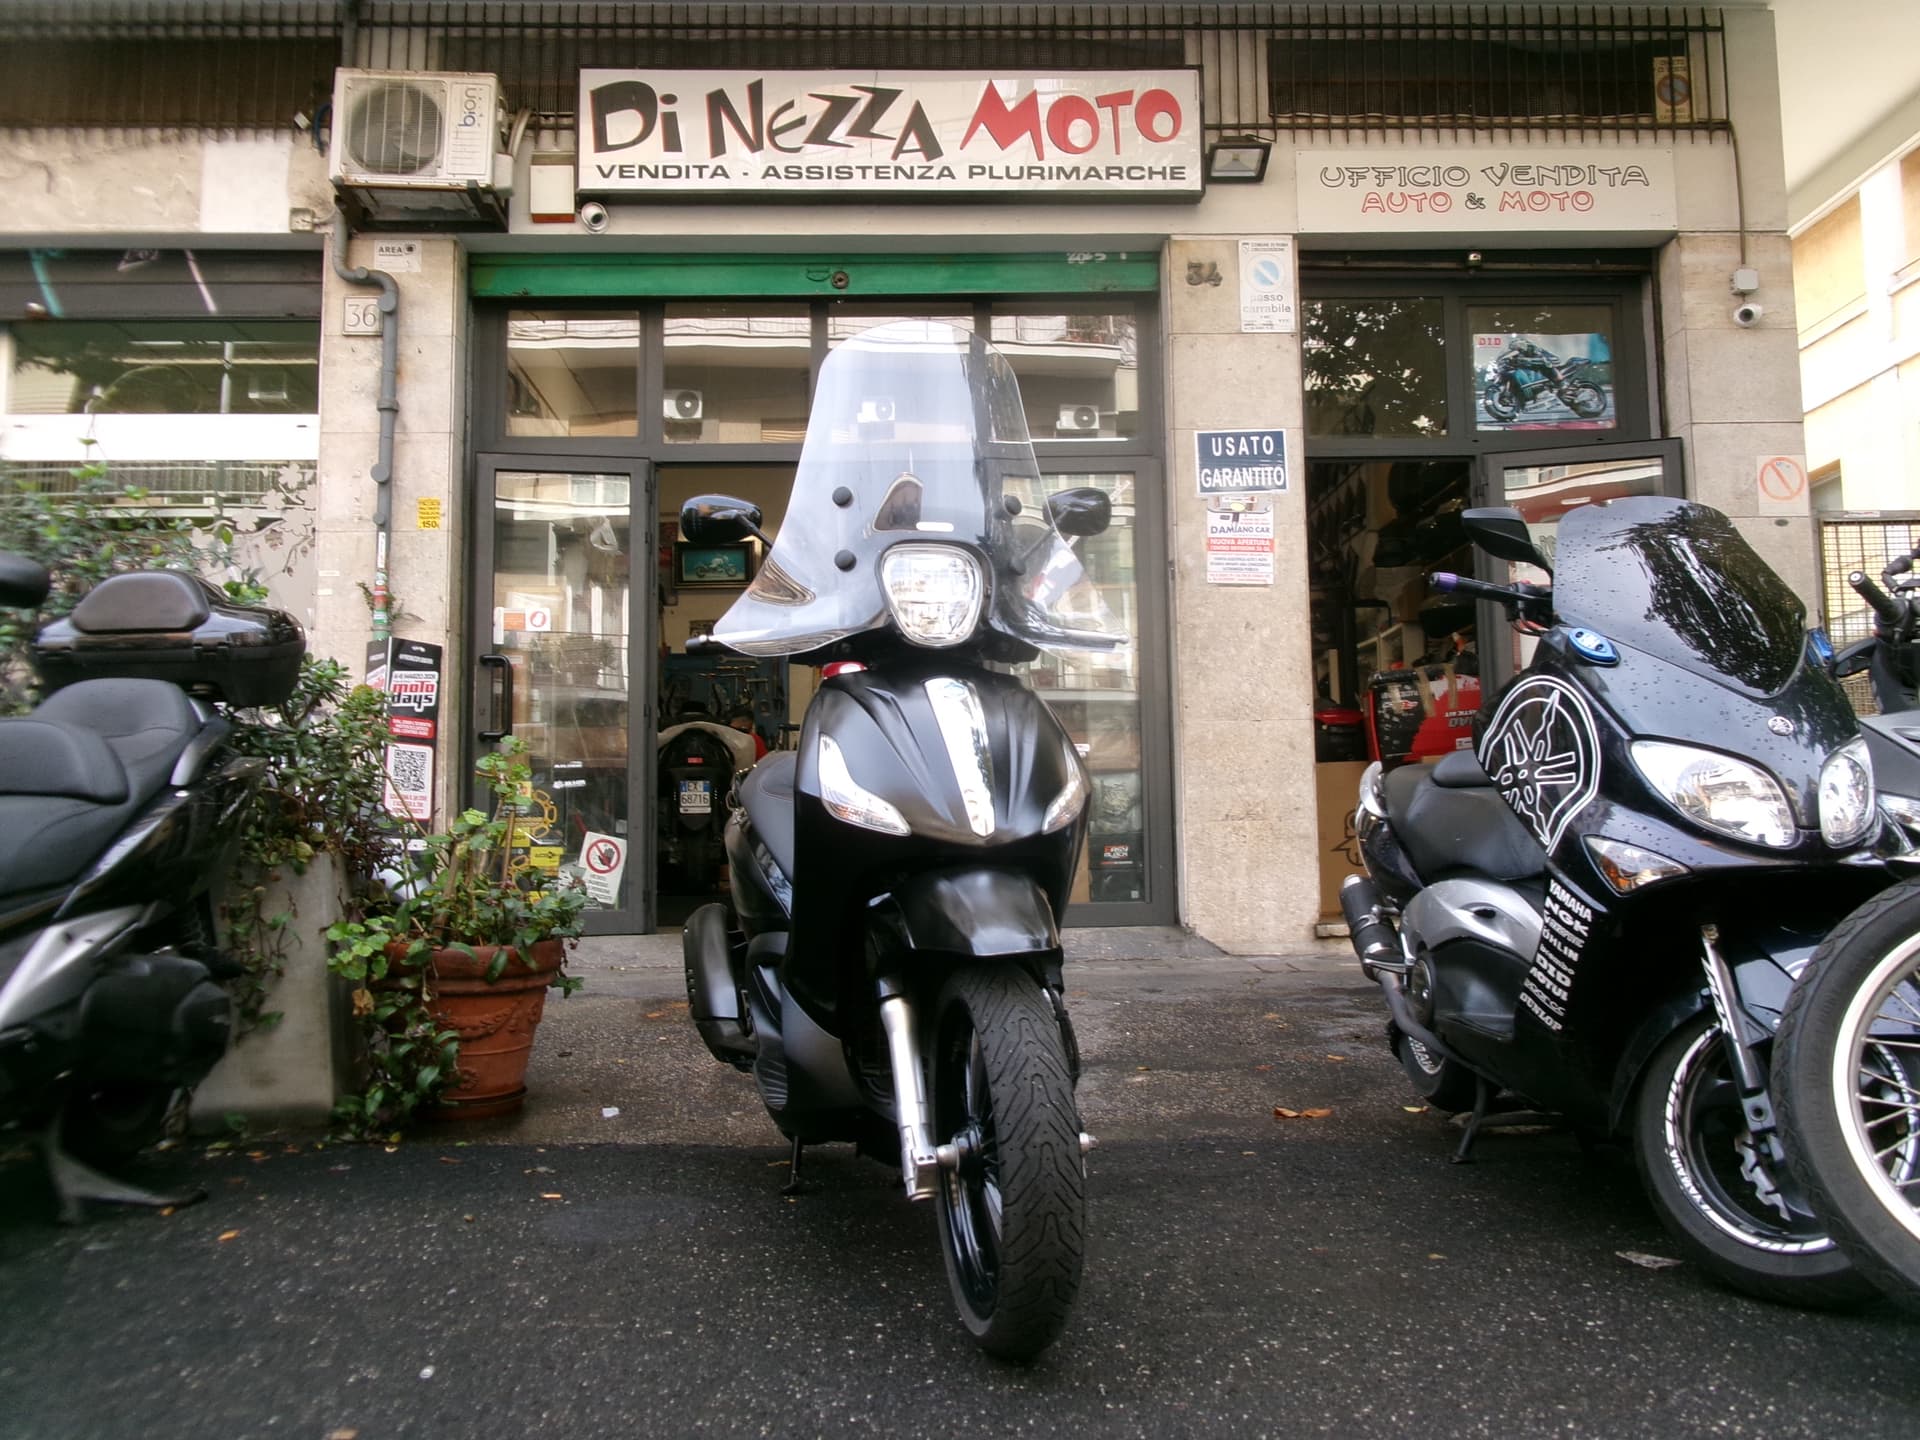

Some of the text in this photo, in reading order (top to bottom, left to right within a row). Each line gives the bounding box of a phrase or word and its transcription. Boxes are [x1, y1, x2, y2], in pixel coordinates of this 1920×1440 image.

[960, 78, 1183, 161] MOTO
[596, 164, 731, 180] VENDITA
[761, 164, 957, 181] ASSISTENZA
[968, 164, 1187, 181] PLURIMARCHE
[1320, 162, 1650, 188] UFFICIO VENDITA
[1361, 191, 1594, 213] AUTO & MOTO
[1243, 303, 1292, 313] carrabile
[1250, 294, 1284, 303] passo
[347, 303, 378, 328] 36
[1211, 435, 1275, 457] USATO
[1200, 466, 1285, 488] GARANTITO
[1210, 526, 1253, 534] DAMIANO
[392, 680, 435, 693] moto
[391, 693, 434, 709] days
[1549, 878, 1593, 922] YAMAHA
[1545, 896, 1589, 937] NGK
[1536, 952, 1571, 987] DID
[1519, 991, 1563, 1031] DUNLOP
[1669, 1149, 1703, 1202] YAMAHA
